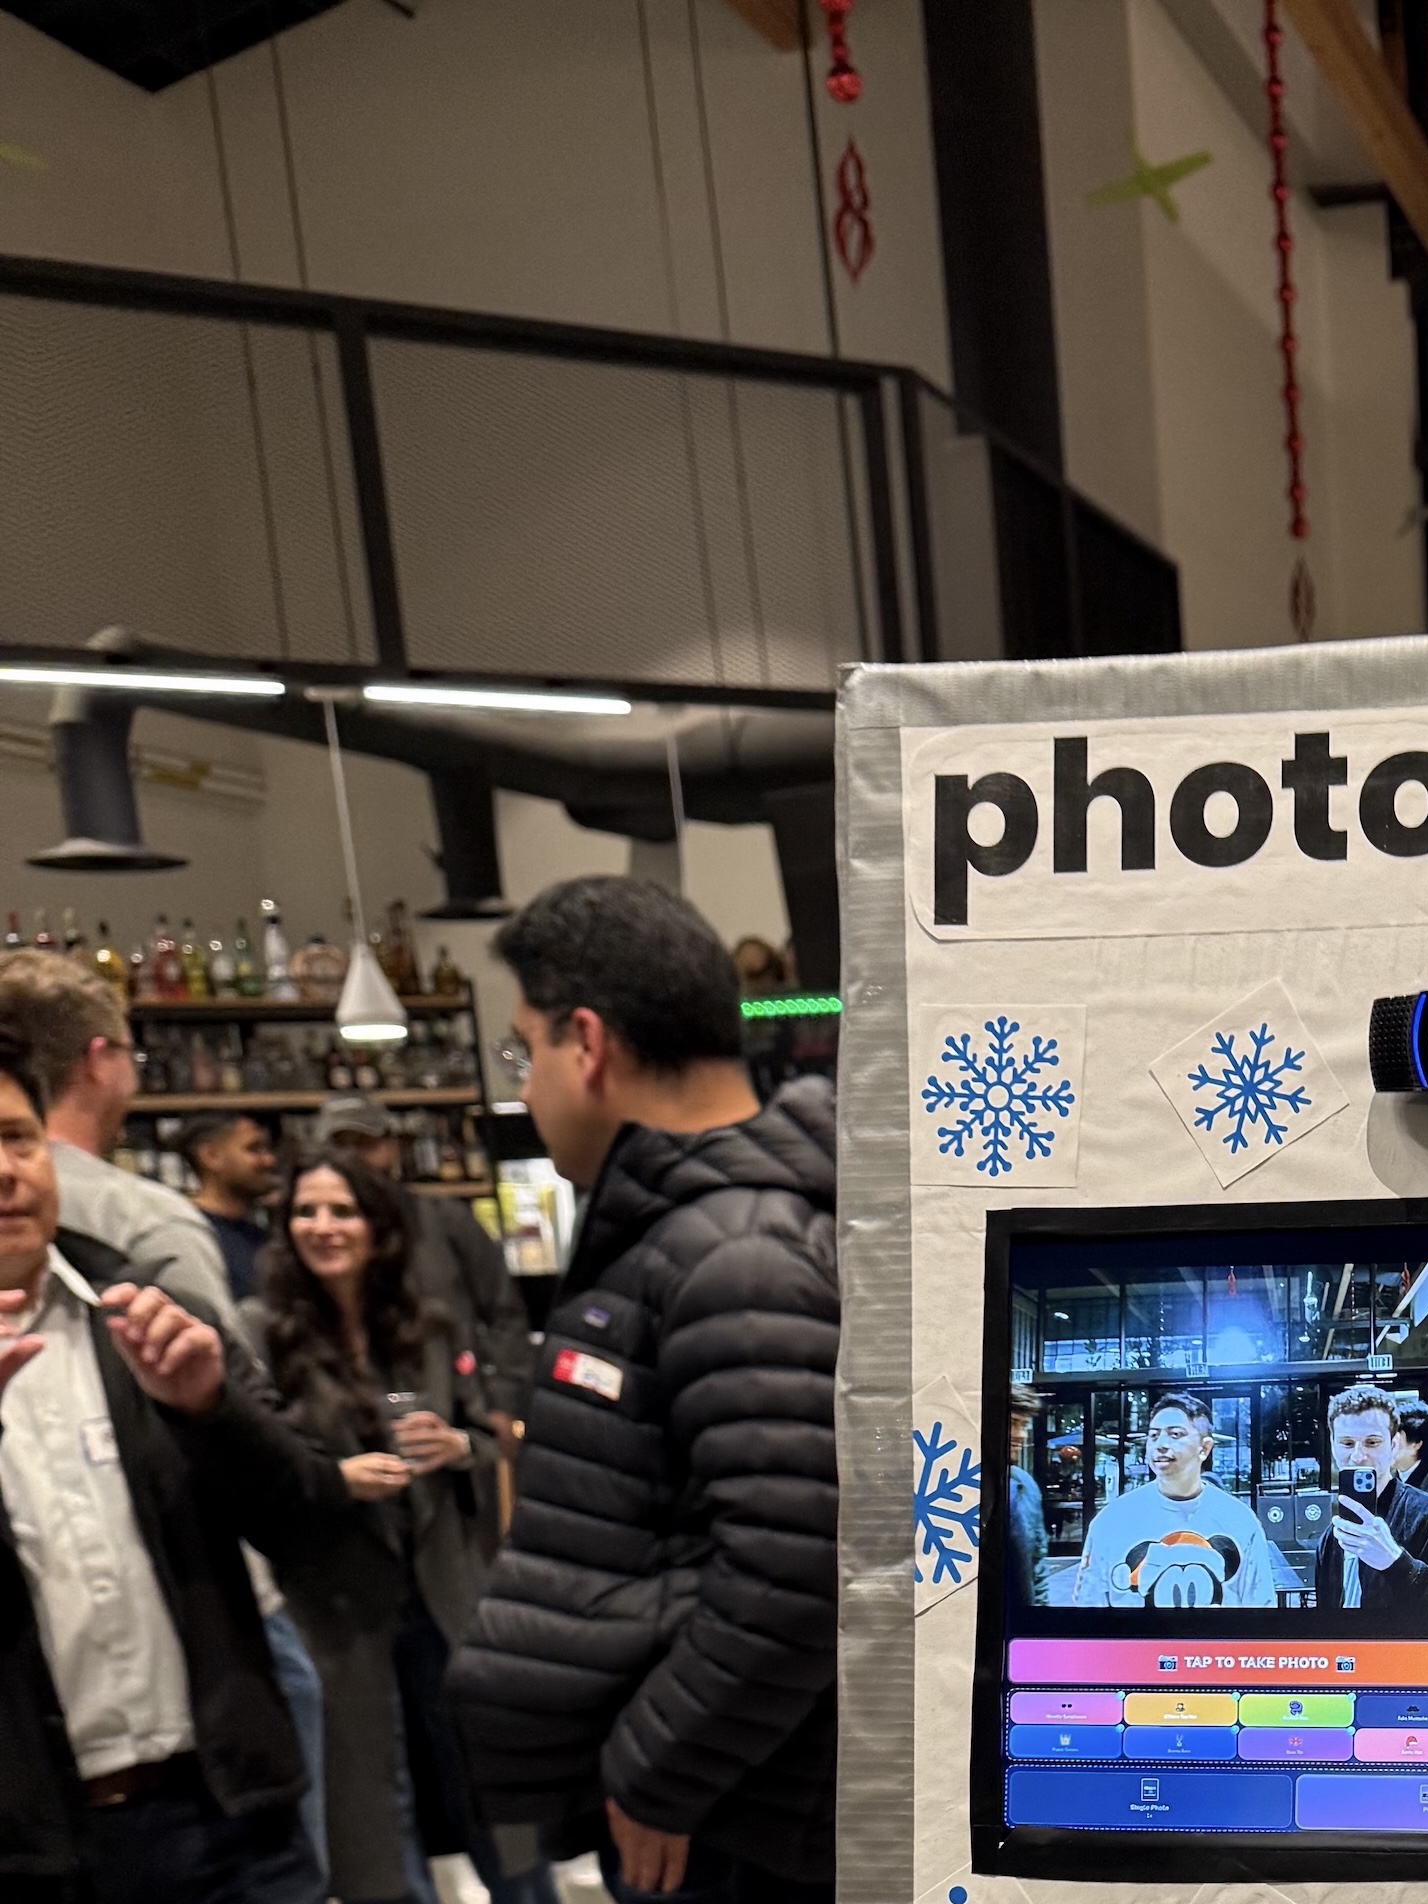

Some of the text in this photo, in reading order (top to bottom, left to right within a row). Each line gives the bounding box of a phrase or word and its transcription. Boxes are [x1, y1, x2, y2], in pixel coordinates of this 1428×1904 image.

[1184, 1656, 1329, 1669] TAP TO TAKE PHOTO
[1150, 1804, 1170, 1812] Photo
